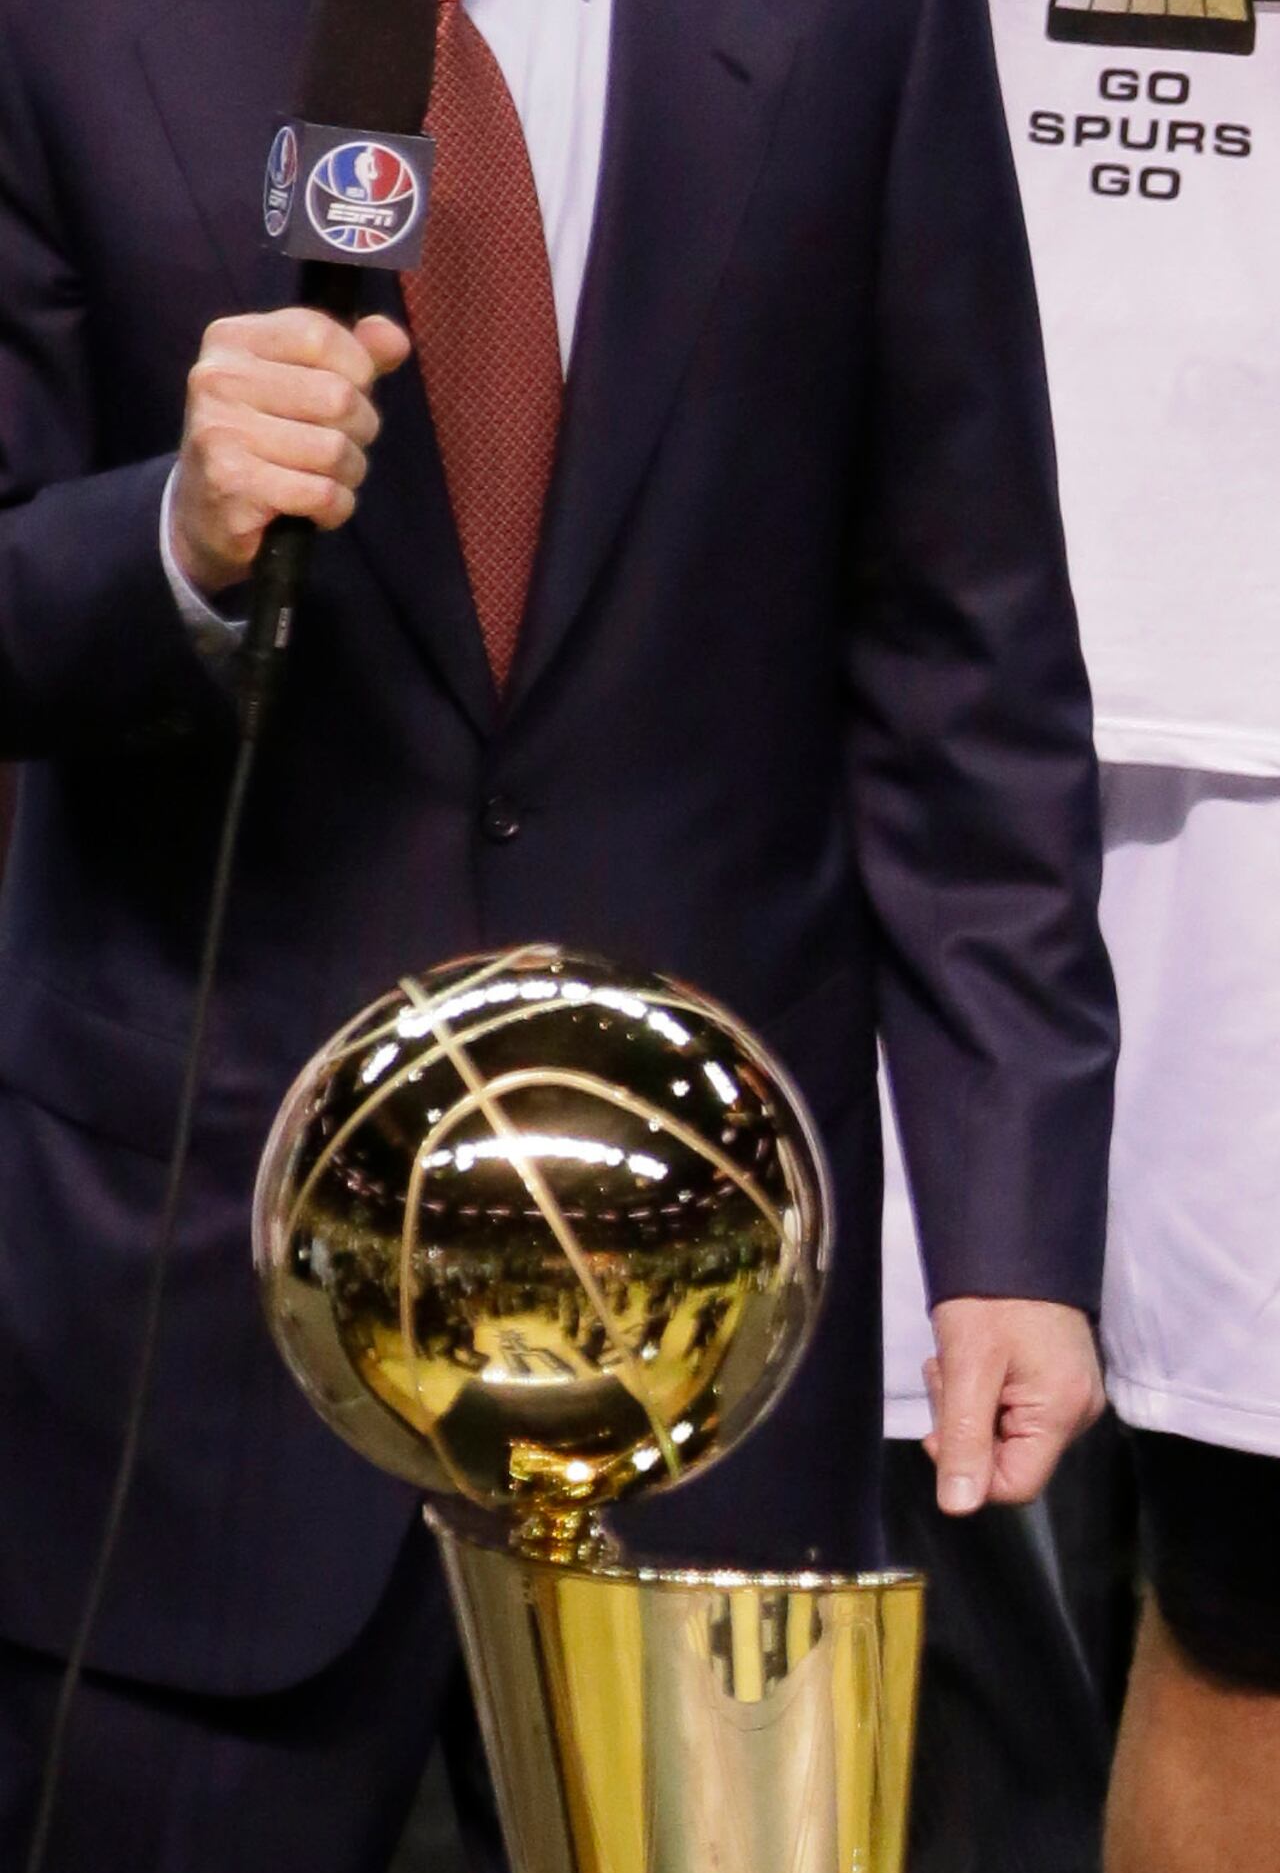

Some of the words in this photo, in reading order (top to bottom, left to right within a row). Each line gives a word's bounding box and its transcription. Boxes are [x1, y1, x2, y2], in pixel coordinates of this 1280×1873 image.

[1099, 68, 1191, 106] GO
[1028, 111, 1252, 158] SPURS
[1090, 163, 1182, 201] GO
